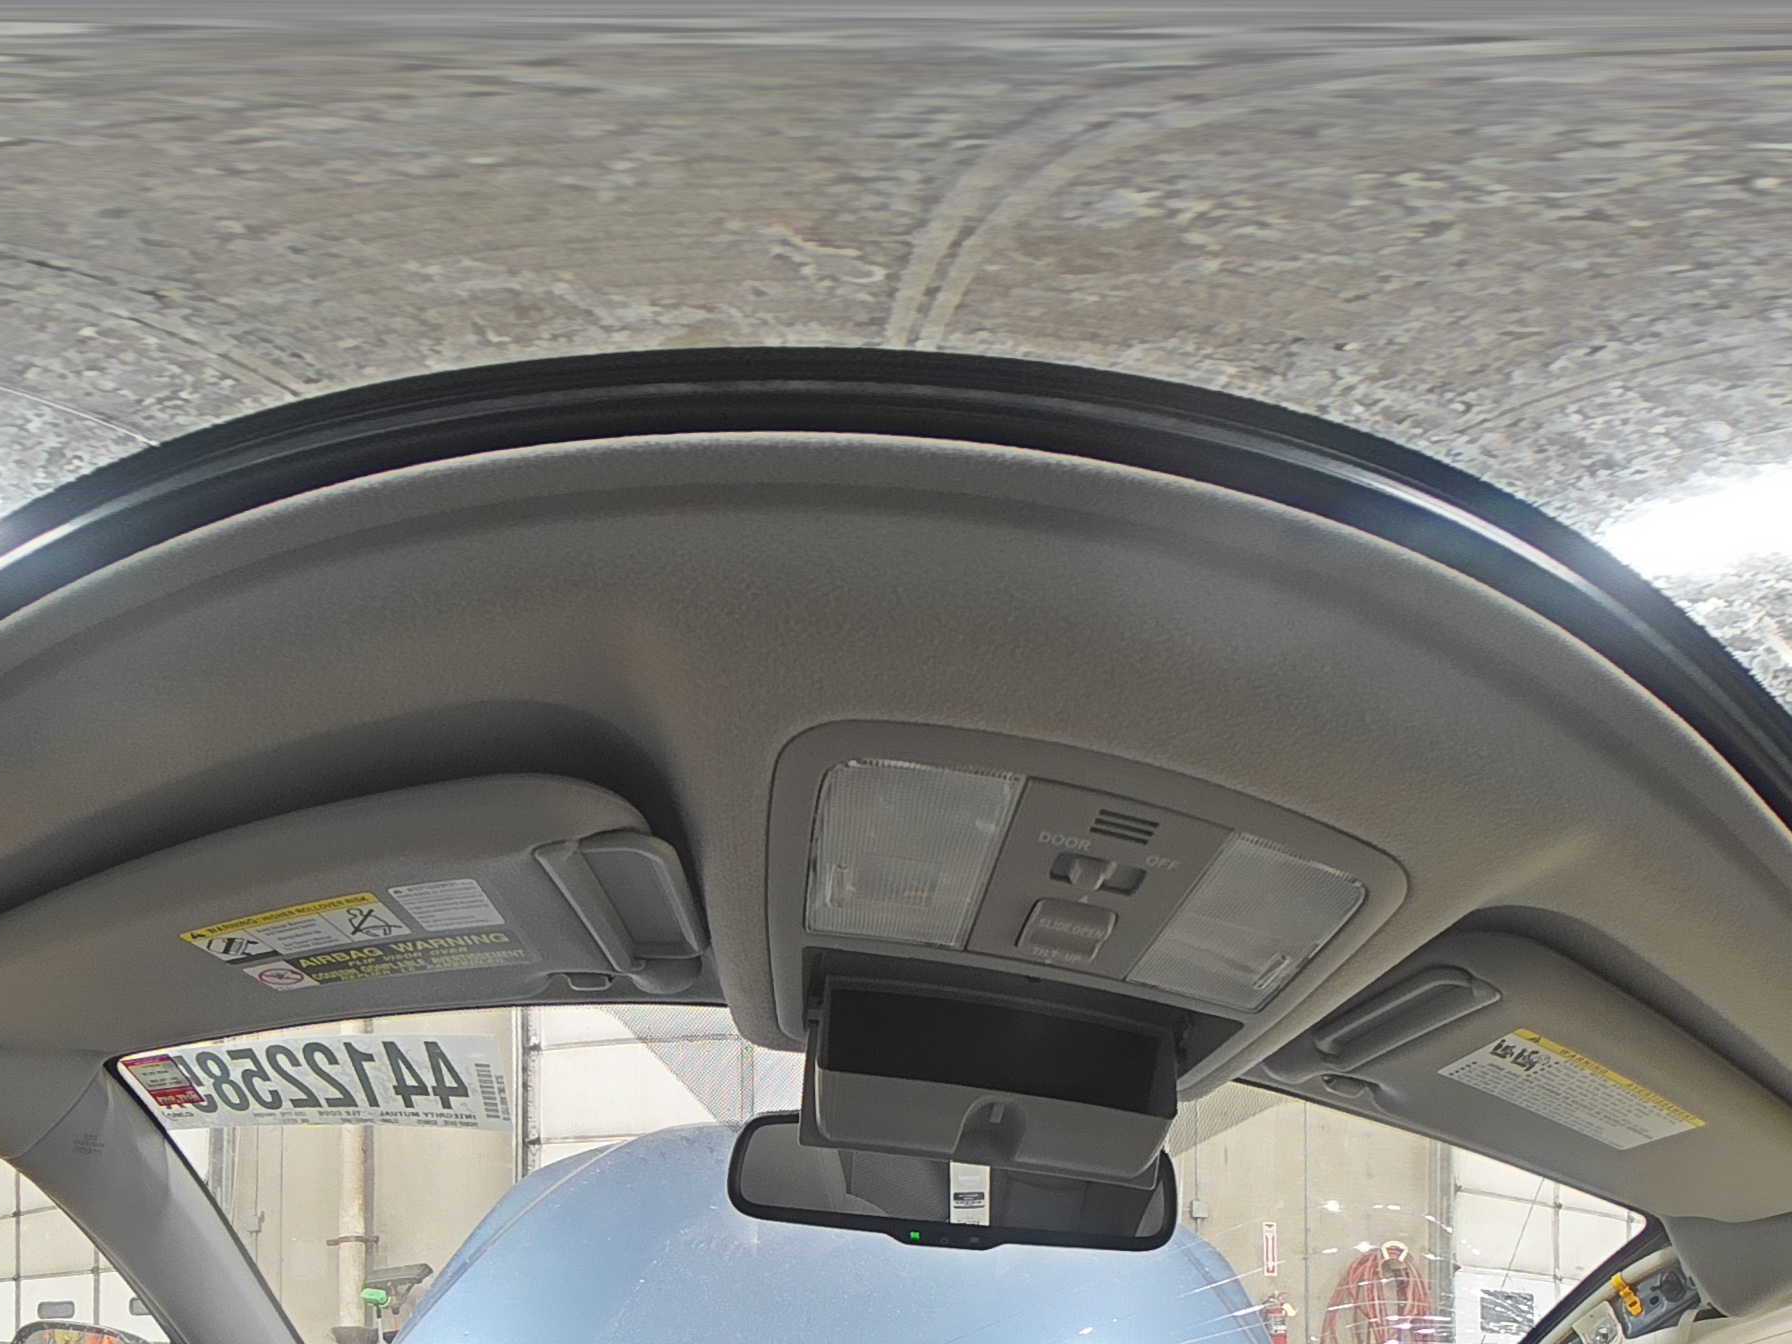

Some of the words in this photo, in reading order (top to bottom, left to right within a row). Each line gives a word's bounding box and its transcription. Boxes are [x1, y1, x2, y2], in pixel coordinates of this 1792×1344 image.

[1037, 831, 1092, 851] DOOR
[1144, 854, 1181, 872] OFF
[295, 899, 343, 916] ROLLOVER
[1039, 917, 1072, 933] SLIDE
[1072, 924, 1106, 939] OPEN
[298, 947, 383, 968] AIRBAG
[390, 932, 510, 953] WARNING
[348, 956, 377, 967] FLIP
[383, 951, 422, 961] VISOR
[433, 946, 468, 955] OVER
[1032, 946, 1059, 958] TILT
[1065, 952, 1082, 963] UP
[1560, 1049, 1609, 1075] WARNING
